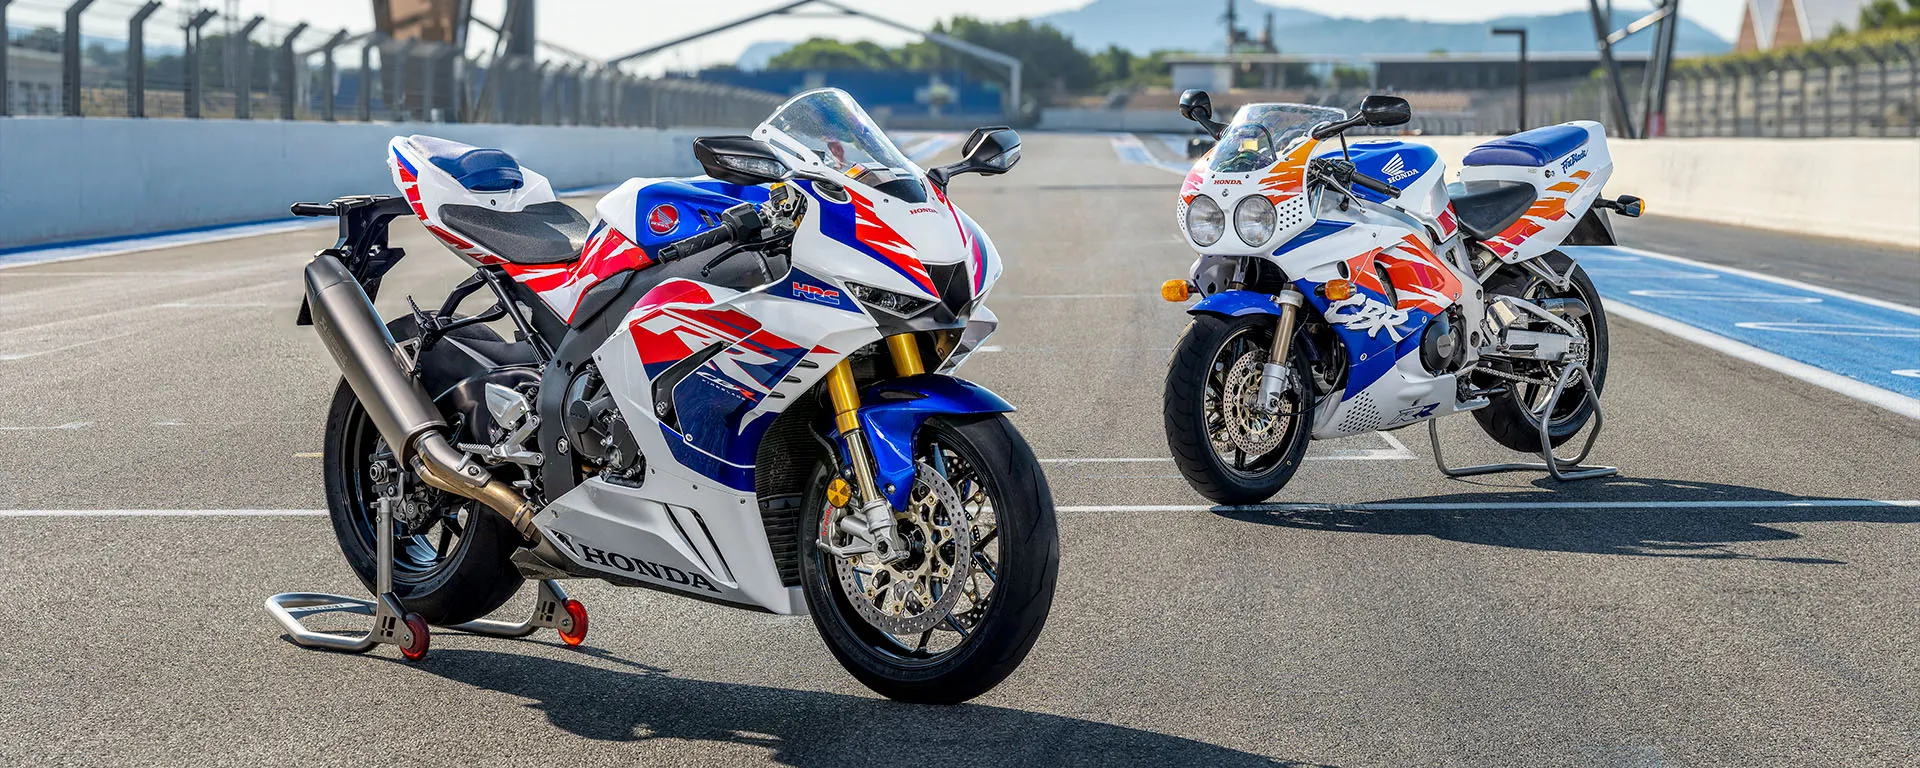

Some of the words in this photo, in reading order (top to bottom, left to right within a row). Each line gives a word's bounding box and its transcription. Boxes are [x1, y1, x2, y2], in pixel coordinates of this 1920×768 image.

[1387, 168, 1419, 184] HONDA
[793, 281, 840, 305] HRC
[1323, 292, 1409, 343] CBR
[696, 371, 759, 403] CBR
[578, 543, 722, 594] HONDA
